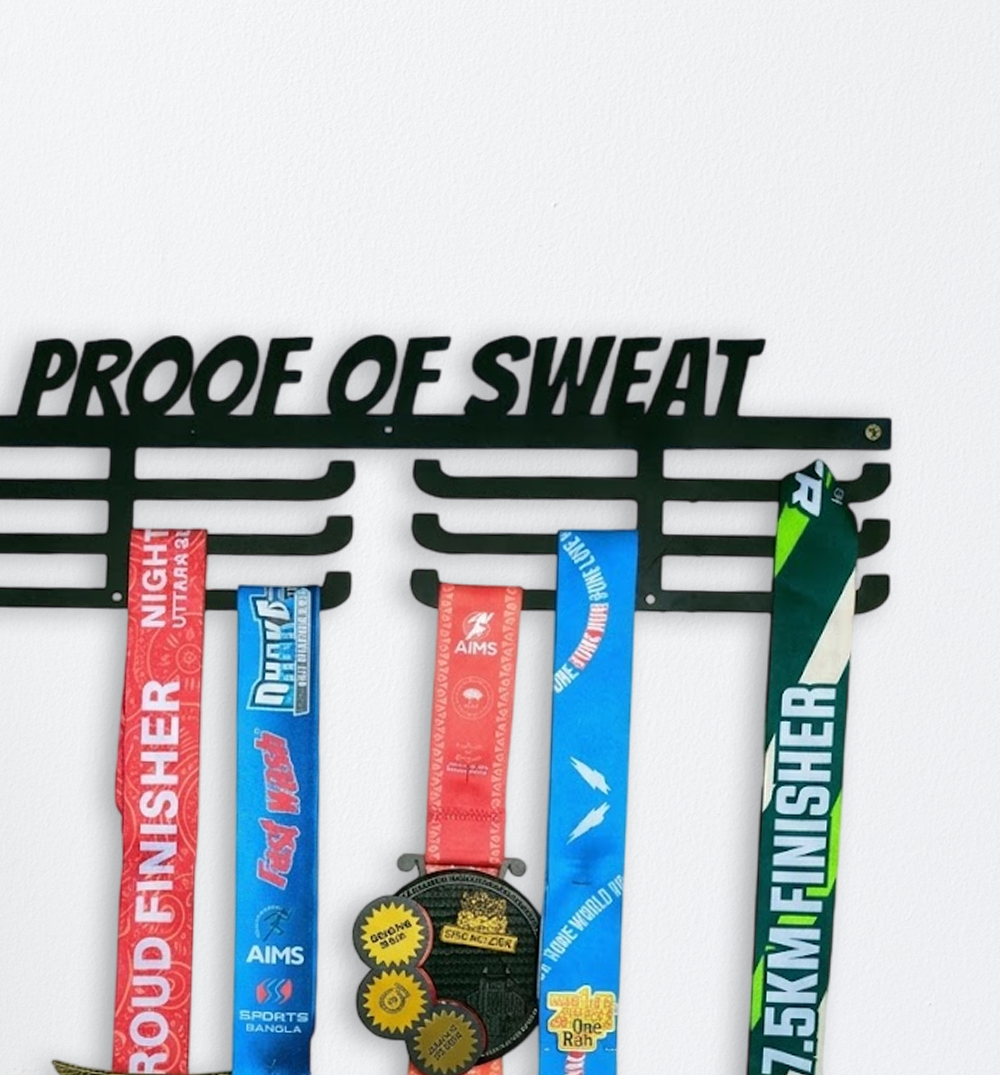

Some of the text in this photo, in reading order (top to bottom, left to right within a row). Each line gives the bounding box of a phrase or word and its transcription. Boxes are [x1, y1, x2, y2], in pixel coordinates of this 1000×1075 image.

[17, 335, 766, 416] PROOF OF SWEAT
[141, 529, 169, 628] NIGHT
[172, 553, 189, 628] UTTARA
[454, 640, 498, 656] AIMS
[135, 680, 180, 924] FINISHER
[761, 686, 837, 1075] 7.5KM FINISHER
[246, 944, 305, 965] AIMS
[239, 1010, 309, 1023] SPORTS
[245, 1023, 303, 1034] BANGLA
